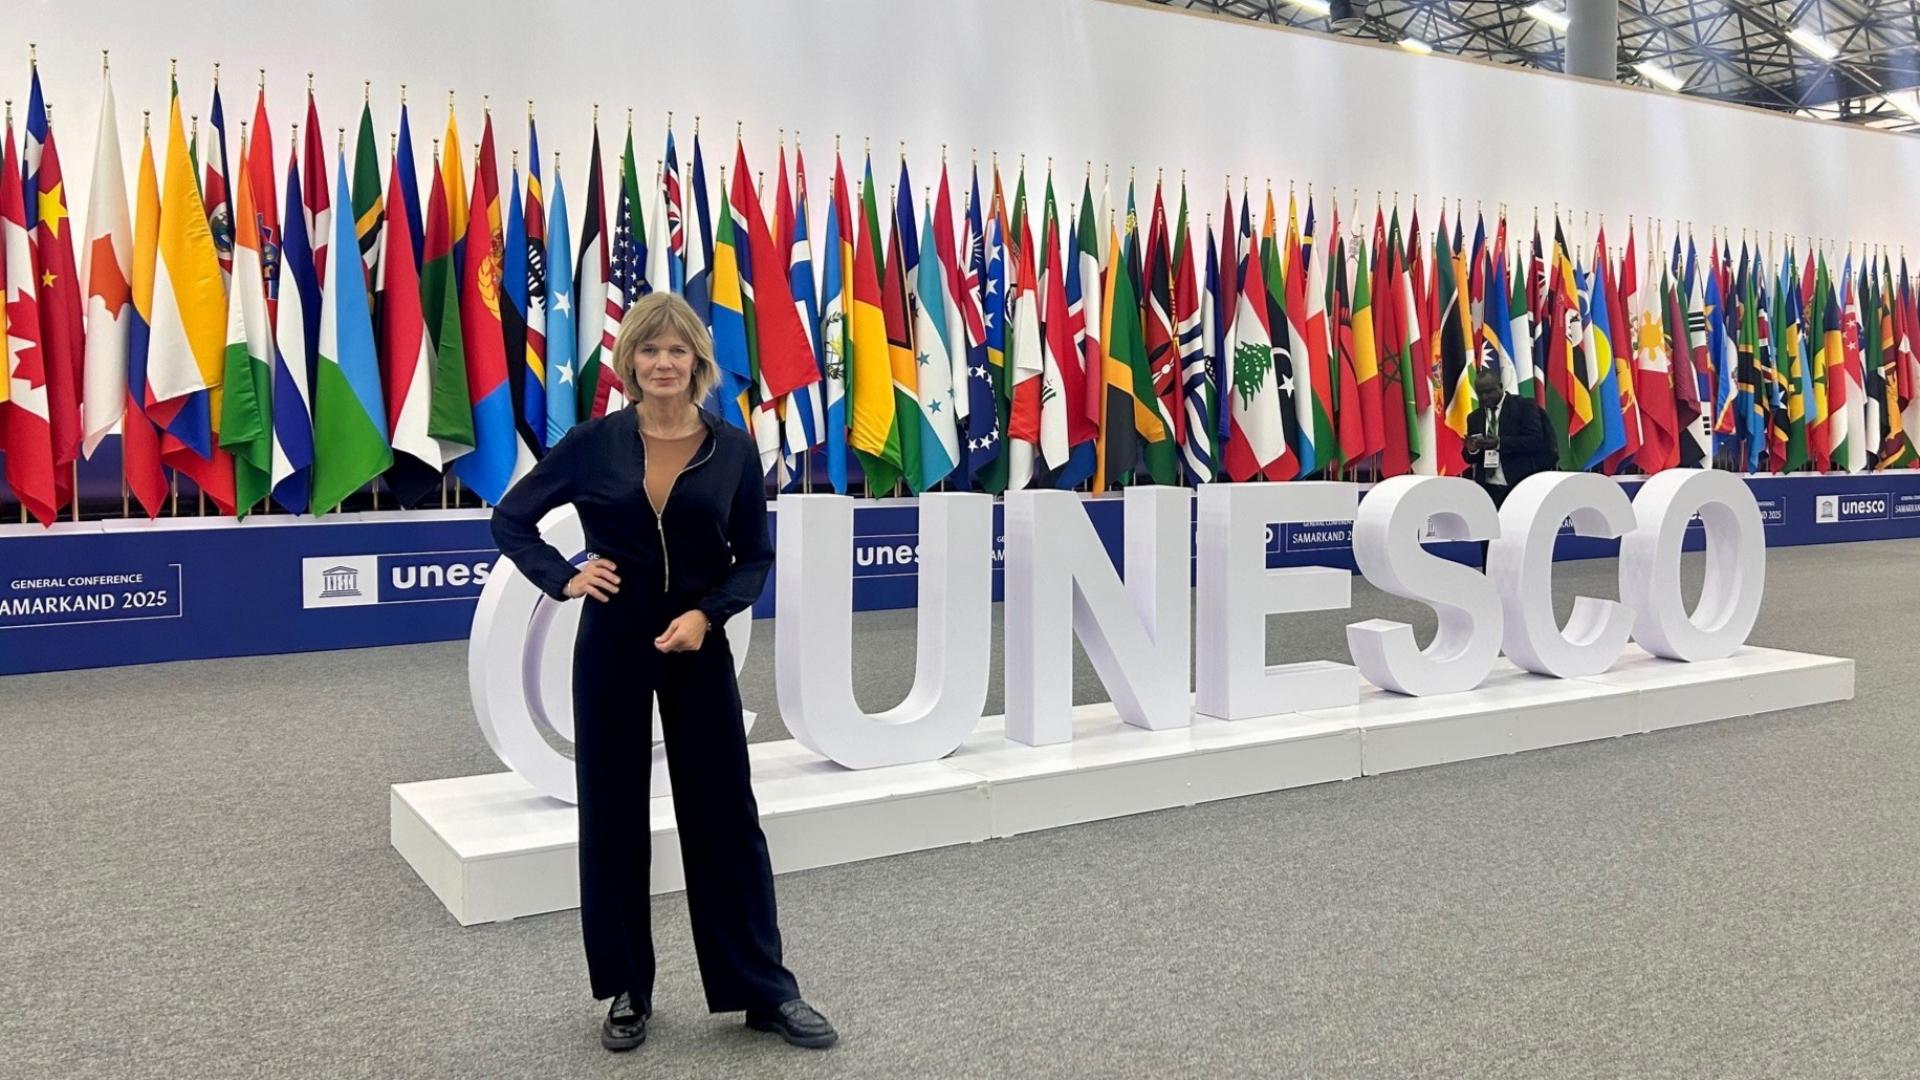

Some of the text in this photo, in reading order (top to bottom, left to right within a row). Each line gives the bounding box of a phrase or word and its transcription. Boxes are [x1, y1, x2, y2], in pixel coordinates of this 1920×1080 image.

[1842, 500, 1885, 514] unesco
[1292, 531, 1345, 544] SAMARKAND
[856, 544, 919, 566] une
[11, 574, 143, 590] GENERAL CONFERENCE
[392, 562, 491, 589] unes
[0, 590, 167, 616] AMARKAND 2025
